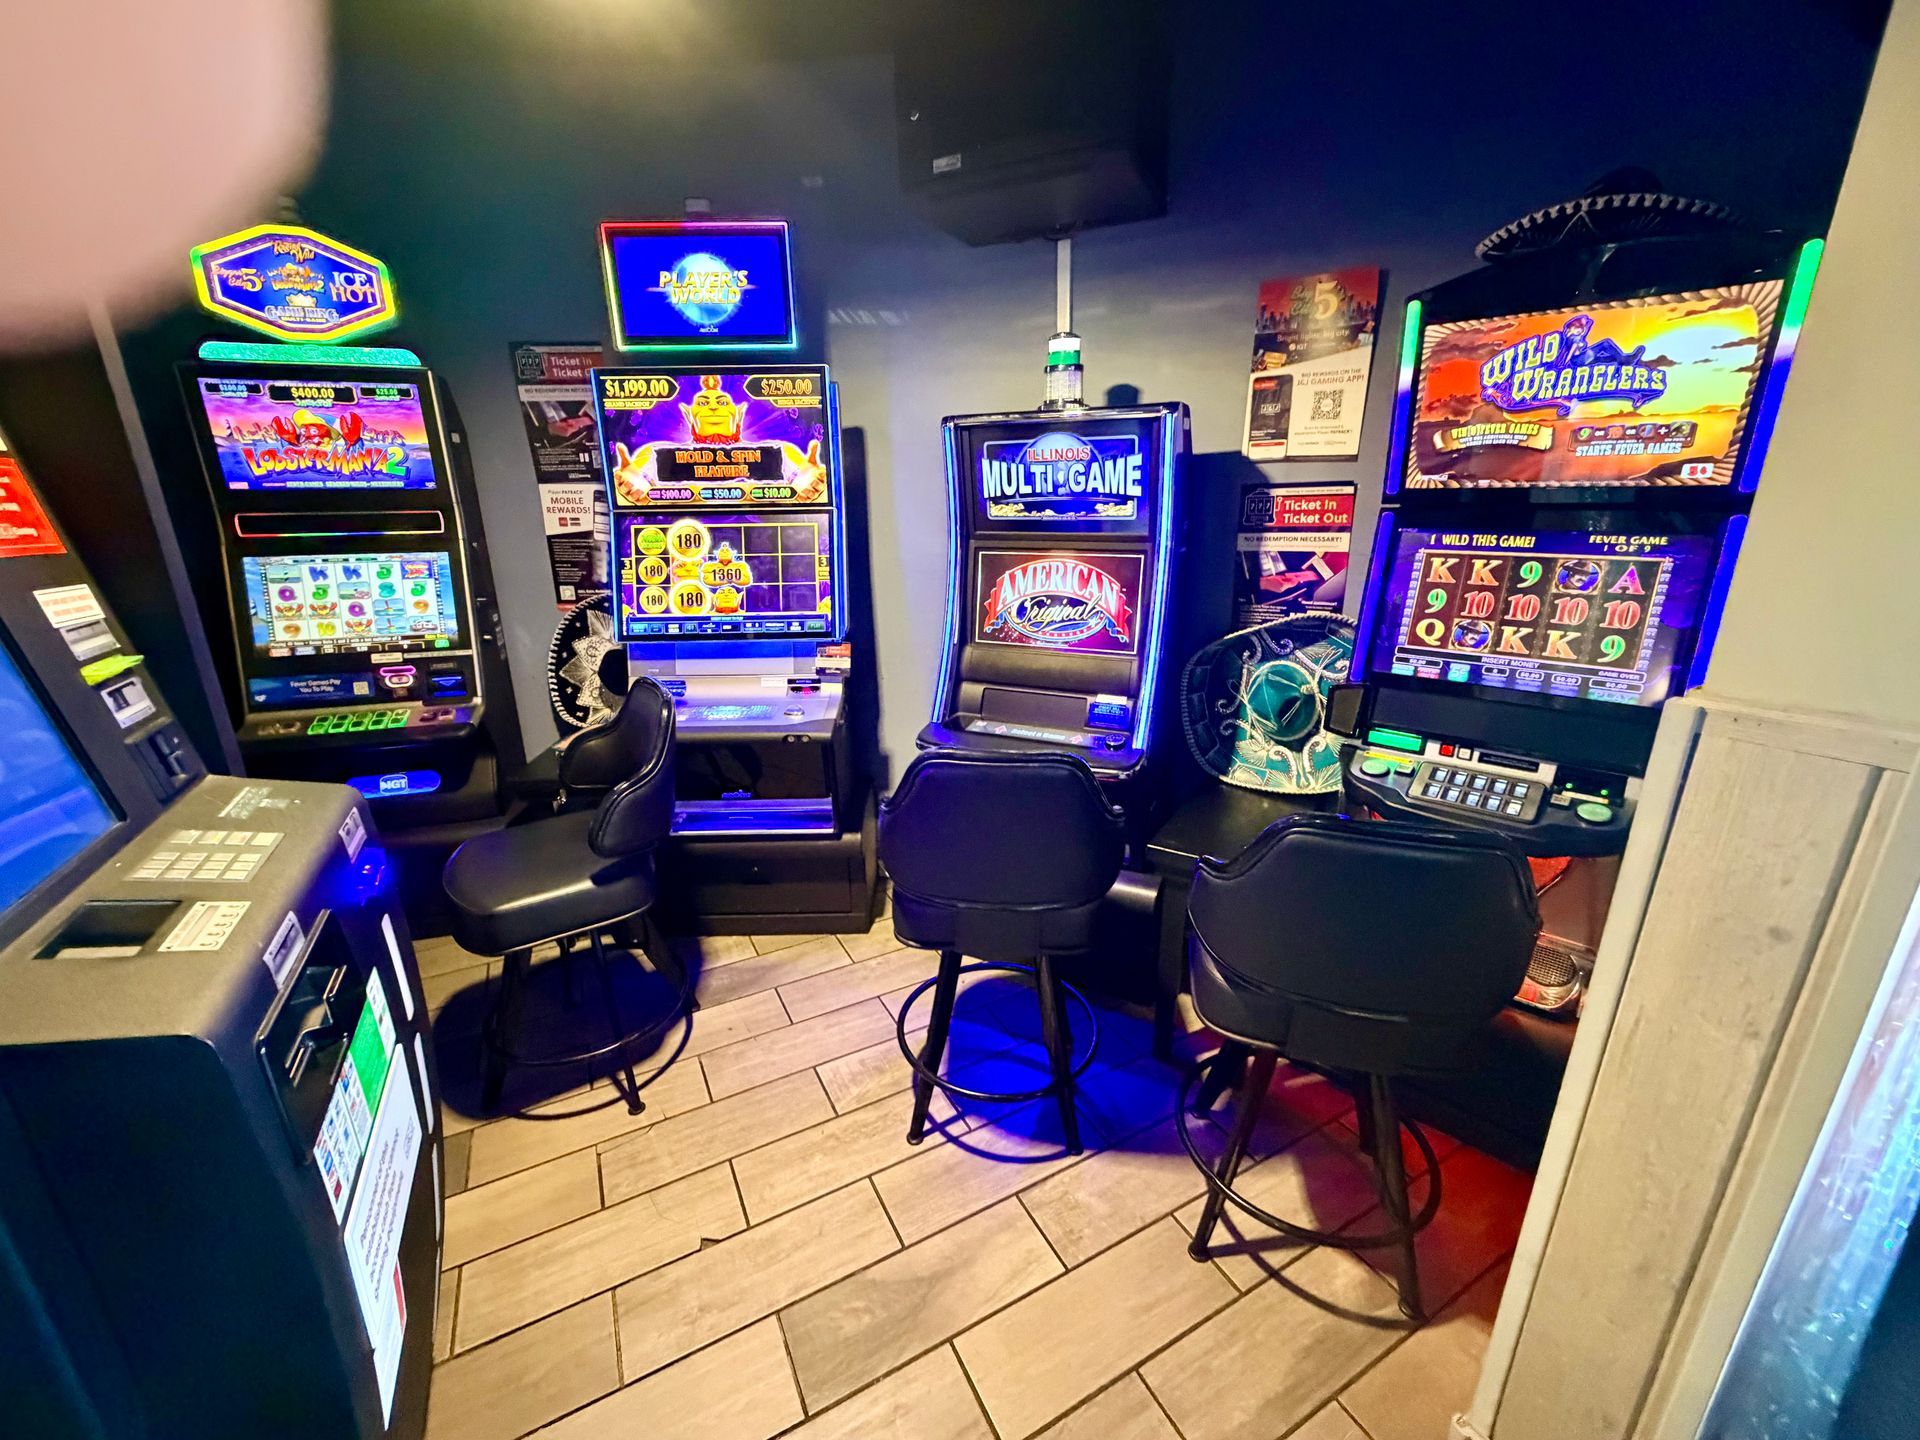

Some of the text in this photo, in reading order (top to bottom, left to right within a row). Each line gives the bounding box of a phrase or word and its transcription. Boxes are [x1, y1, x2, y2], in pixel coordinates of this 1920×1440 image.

[331, 272, 368, 288] ICE
[659, 269, 749, 288] PLAYER'S
[329, 283, 375, 303] HOT
[669, 286, 741, 305] WORLD
[550, 356, 580, 366] Ticket
[1483, 333, 1561, 387] WILD
[552, 368, 582, 377] Ticket
[1311, 377, 1344, 385] GAMING
[1511, 363, 1666, 402] WRANGLERS
[291, 388, 335, 399] $400.00
[605, 379, 813, 397] $1,199.00 $250.00
[1027, 446, 1091, 462] ILLINOIS
[1575, 444, 1612, 456] STARTS
[1647, 443, 1682, 455] GAMES
[675, 450, 761, 463] HOLD & SPIN
[694, 465, 750, 478] FEATURE
[981, 452, 1143, 499] MULTI GAME
[661, 489, 692, 499] $100.00
[713, 488, 742, 498] $50.00
[763, 488, 791, 498] $10.00
[551, 497, 584, 505] MOBILE
[1284, 500, 1337, 511] Ticket In
[546, 506, 591, 514] REWARDS!
[1283, 513, 1348, 523] Ticket Out
[676, 533, 701, 549] 180
[1441, 534, 1469, 546] WILD
[1472, 535, 1497, 547] THIS
[1500, 535, 1536, 548] GAME!
[1589, 535, 1668, 545] FEVER GAME
[644, 565, 663, 577] 180
[711, 568, 742, 581] 1360
[1426, 557, 1645, 595] K K 9 A
[998, 560, 1119, 612] AMERICAN
[645, 595, 663, 606] 180
[679, 592, 703, 607] 180
[1020, 594, 1104, 630] Original
[1424, 588, 1641, 630] 9 10 10 10 10
[1415, 618, 1626, 663] Q K K 9
[1481, 657, 1540, 669] INSERT MONEY
